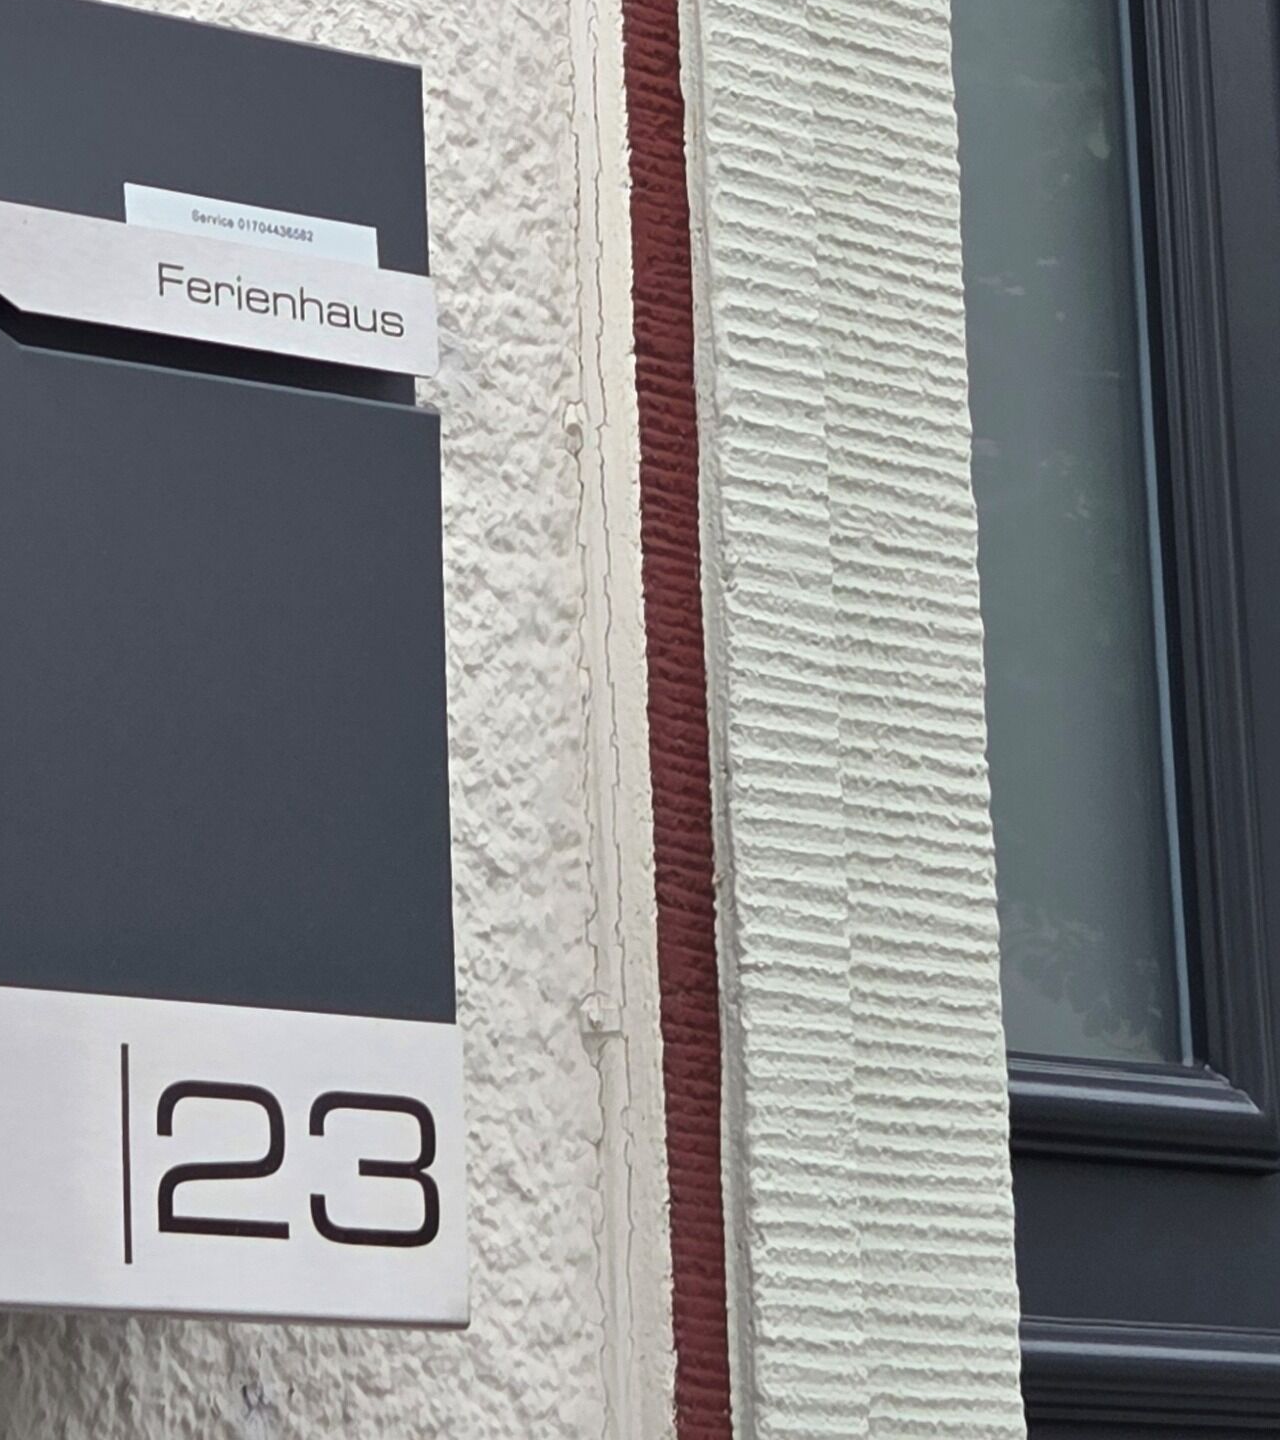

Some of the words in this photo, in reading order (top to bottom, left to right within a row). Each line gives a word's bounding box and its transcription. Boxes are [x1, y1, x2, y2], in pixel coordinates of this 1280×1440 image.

[192, 209, 234, 229] Service
[158, 262, 405, 337] Ferienhaus
[156, 1079, 441, 1249] 23
